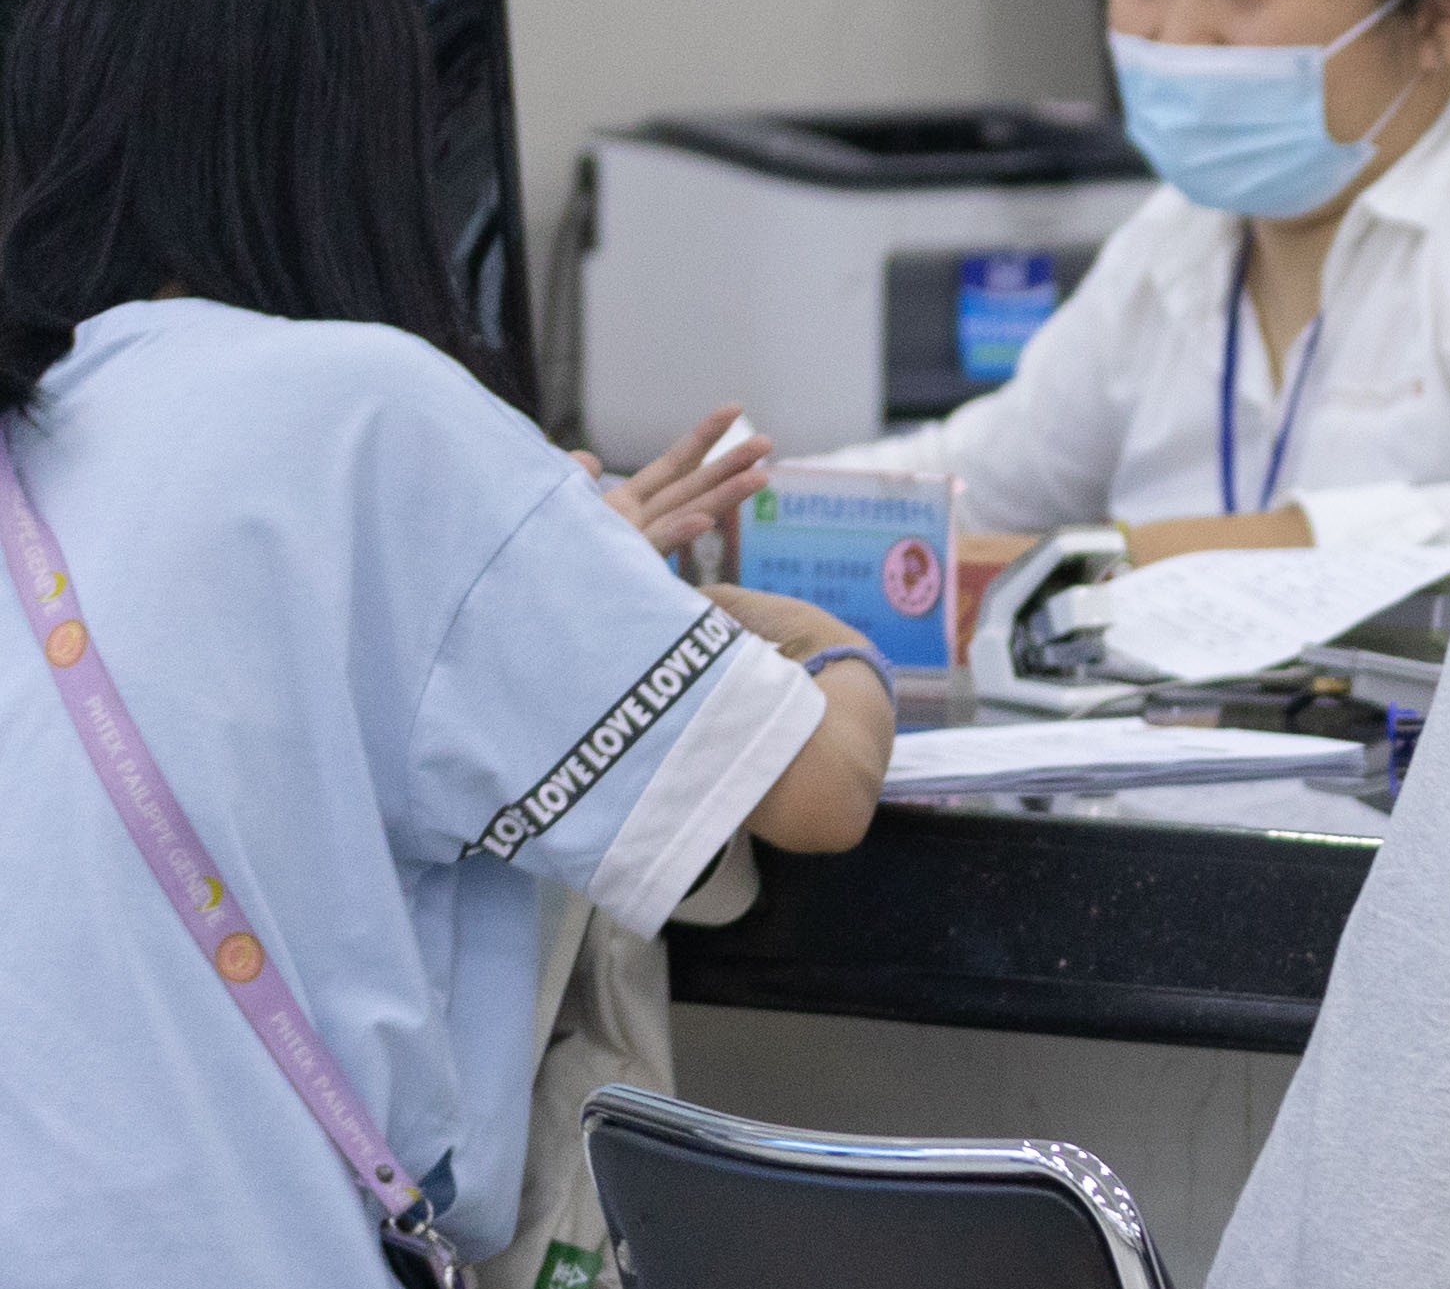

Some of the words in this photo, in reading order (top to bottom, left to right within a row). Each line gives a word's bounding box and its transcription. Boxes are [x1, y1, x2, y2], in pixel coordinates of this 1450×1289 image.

[524, 755, 595, 826] LOVE
[578, 695, 653, 771] LOVE
[637, 638, 710, 710] LOVE
